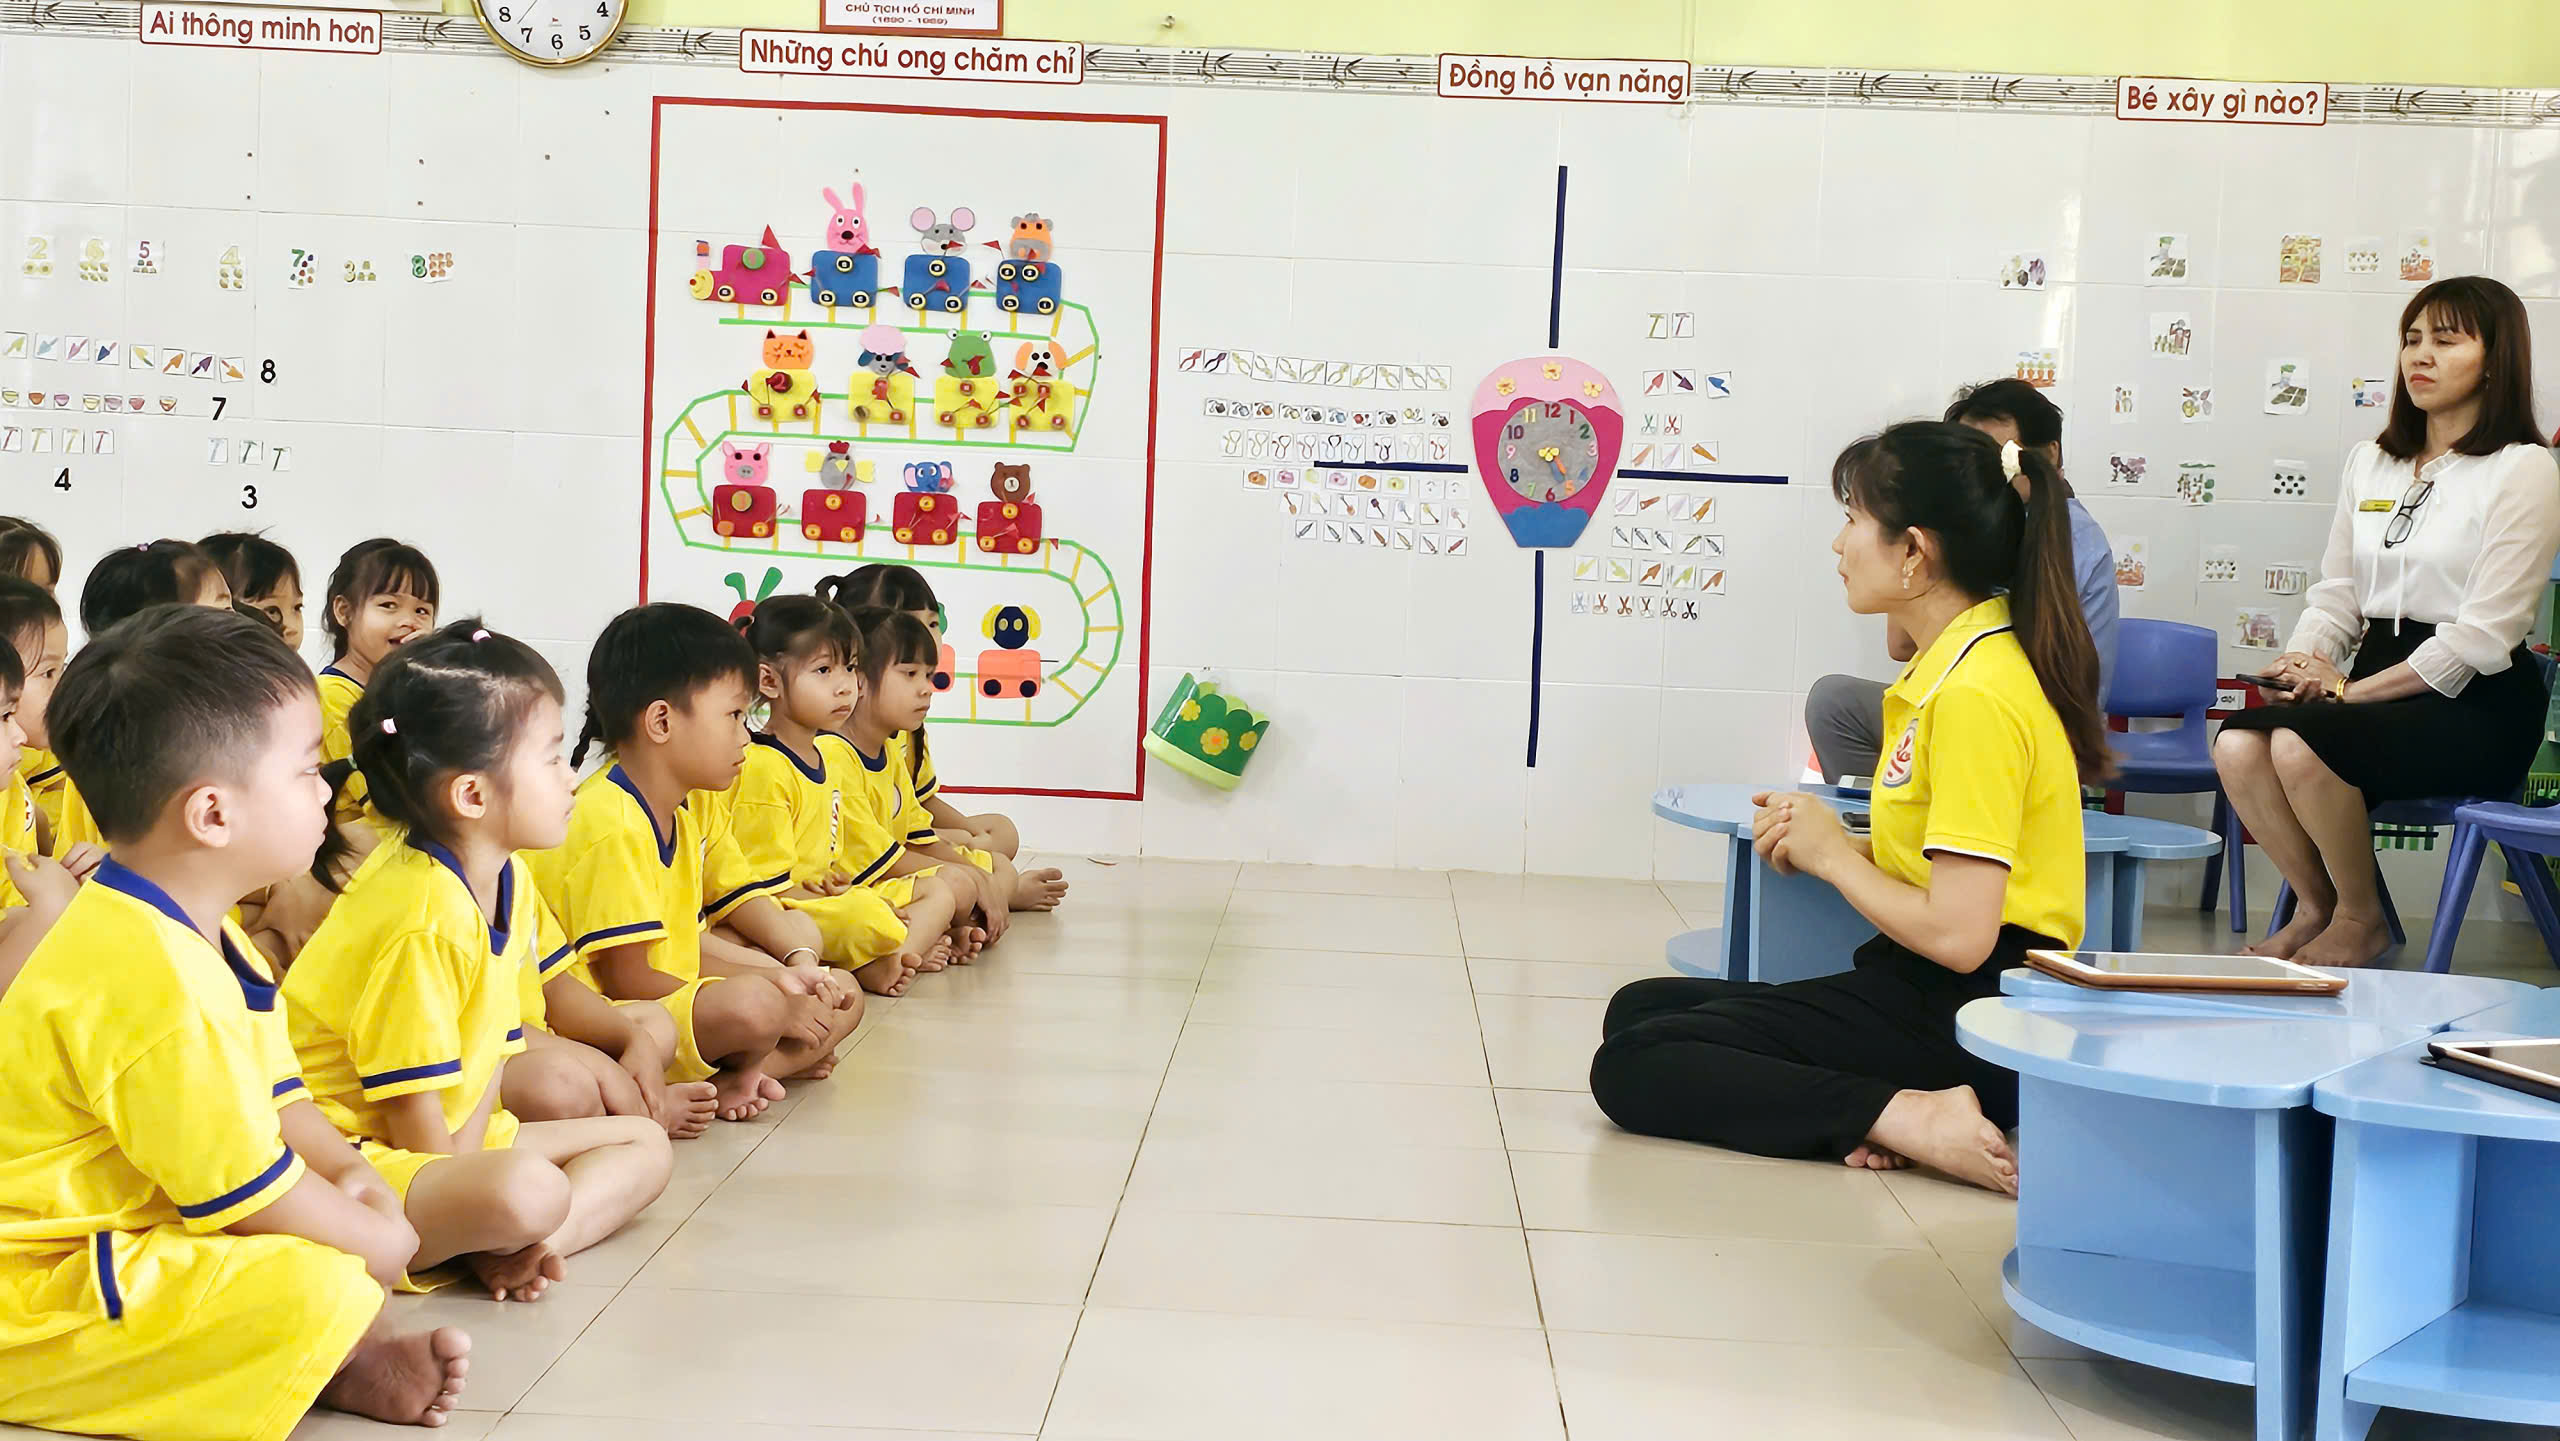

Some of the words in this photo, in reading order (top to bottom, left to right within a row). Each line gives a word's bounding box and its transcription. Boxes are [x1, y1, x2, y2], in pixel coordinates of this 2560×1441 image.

[499, 6, 511, 23] 8
[597, 1, 609, 18] 4
[874, 5, 900, 15] TỊCH
[923, 5, 943, 14] CHÍ
[946, 7, 975, 15] MINH
[150, 11, 174, 35] Ai
[182, 12, 253, 44] thông
[262, 17, 321, 41] minh
[330, 18, 374, 44] hơn
[520, 27, 533, 43] 7
[579, 25, 591, 41] 5
[551, 34, 564, 50] 6
[751, 39, 833, 71] Những
[841, 41, 888, 68] chú
[897, 50, 946, 75] ong
[955, 46, 1028, 73] chăm
[1036, 46, 1076, 74] chỉ
[1450, 59, 1516, 95] Đồng
[1524, 61, 1555, 91] hồ
[1565, 72, 1610, 97] vạn
[1619, 68, 1683, 100] năng
[2127, 85, 2158, 111] Bé
[2167, 87, 2215, 117] xây
[2223, 88, 2247, 119] gì
[2254, 88, 2318, 115] nào?
[27, 237, 48, 260] 2
[138, 240, 151, 259] 5
[220, 245, 241, 265] 4
[291, 249, 305, 267] 7
[411, 255, 427, 278] 8
[344, 260, 356, 283] 3
[260, 359, 276, 384] 8
[212, 397, 227, 421] 7
[1523, 408, 1537, 424] 11
[1544, 403, 1561, 418] 12
[1569, 410, 1575, 424] 1
[1506, 425, 1524, 440] 10
[1579, 424, 1590, 439] 2
[1506, 445, 1516, 460] 9
[1587, 441, 1598, 457] 3
[54, 467, 71, 491] 4
[1510, 468, 1519, 483] 8
[1528, 482, 1536, 497] 7
[1546, 488, 1555, 502] 6
[1565, 480, 1576, 496] 5
[241, 485, 257, 509] 3
